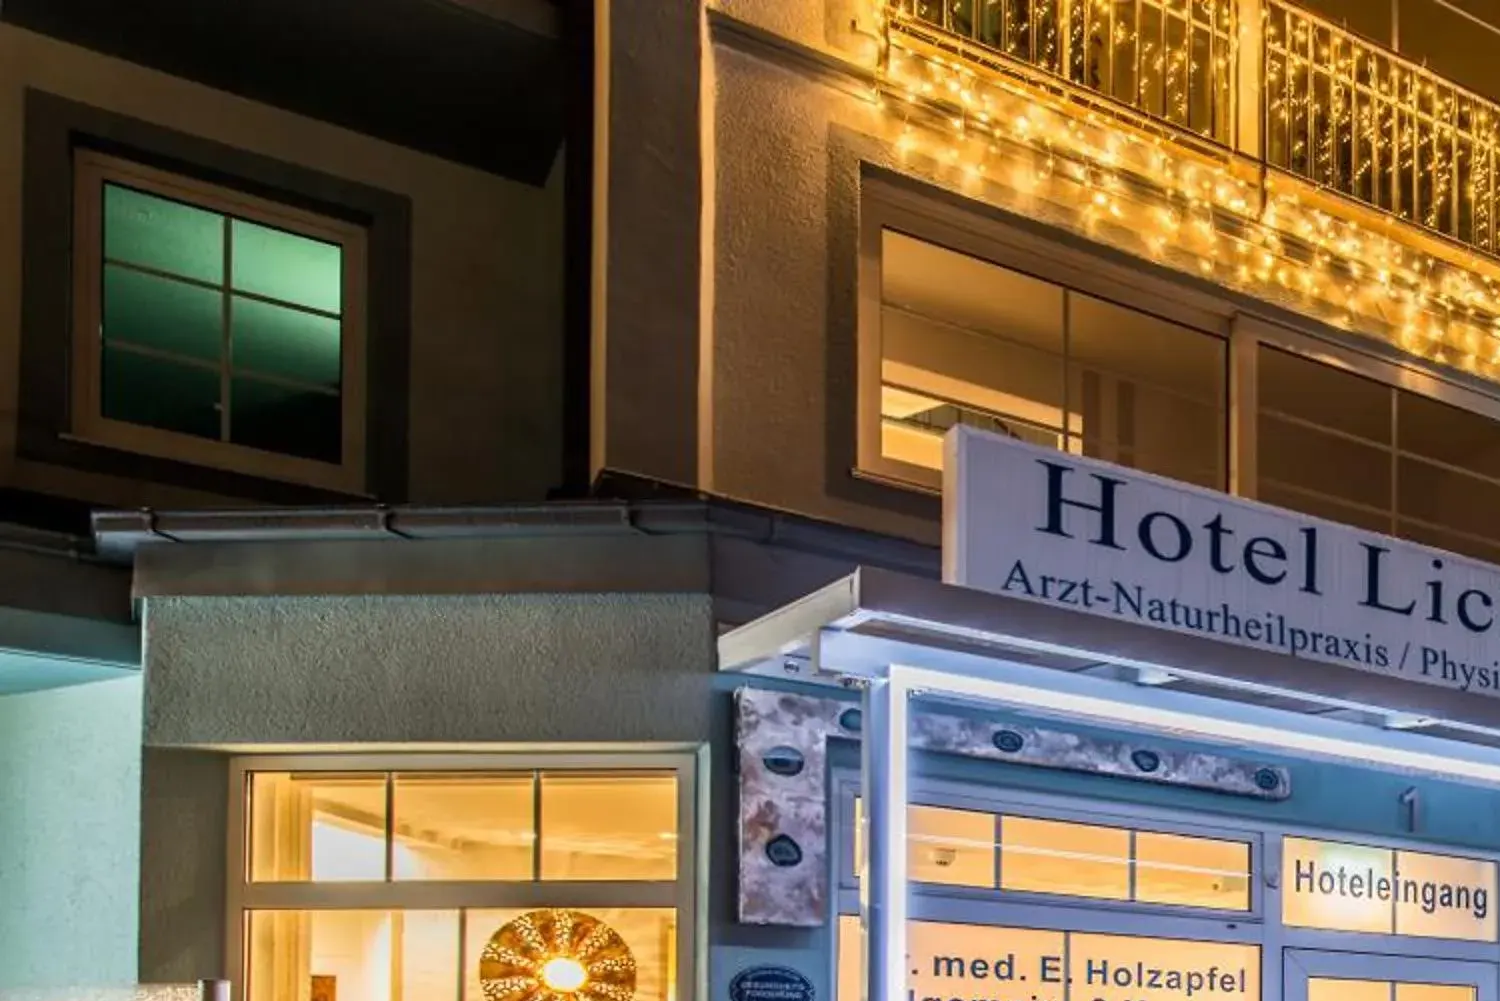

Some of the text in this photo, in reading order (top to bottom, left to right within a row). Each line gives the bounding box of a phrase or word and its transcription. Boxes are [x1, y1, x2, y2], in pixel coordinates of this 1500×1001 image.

[1035, 459, 1323, 595] Hotel
[1001, 559, 1390, 668] Arzt-Naturheilpraxis
[1295, 859, 1487, 919] Hoteleingang
[933, 954, 1026, 981] med.
[1040, 956, 1073, 984] E.
[1086, 959, 1247, 996] Holzapfel
